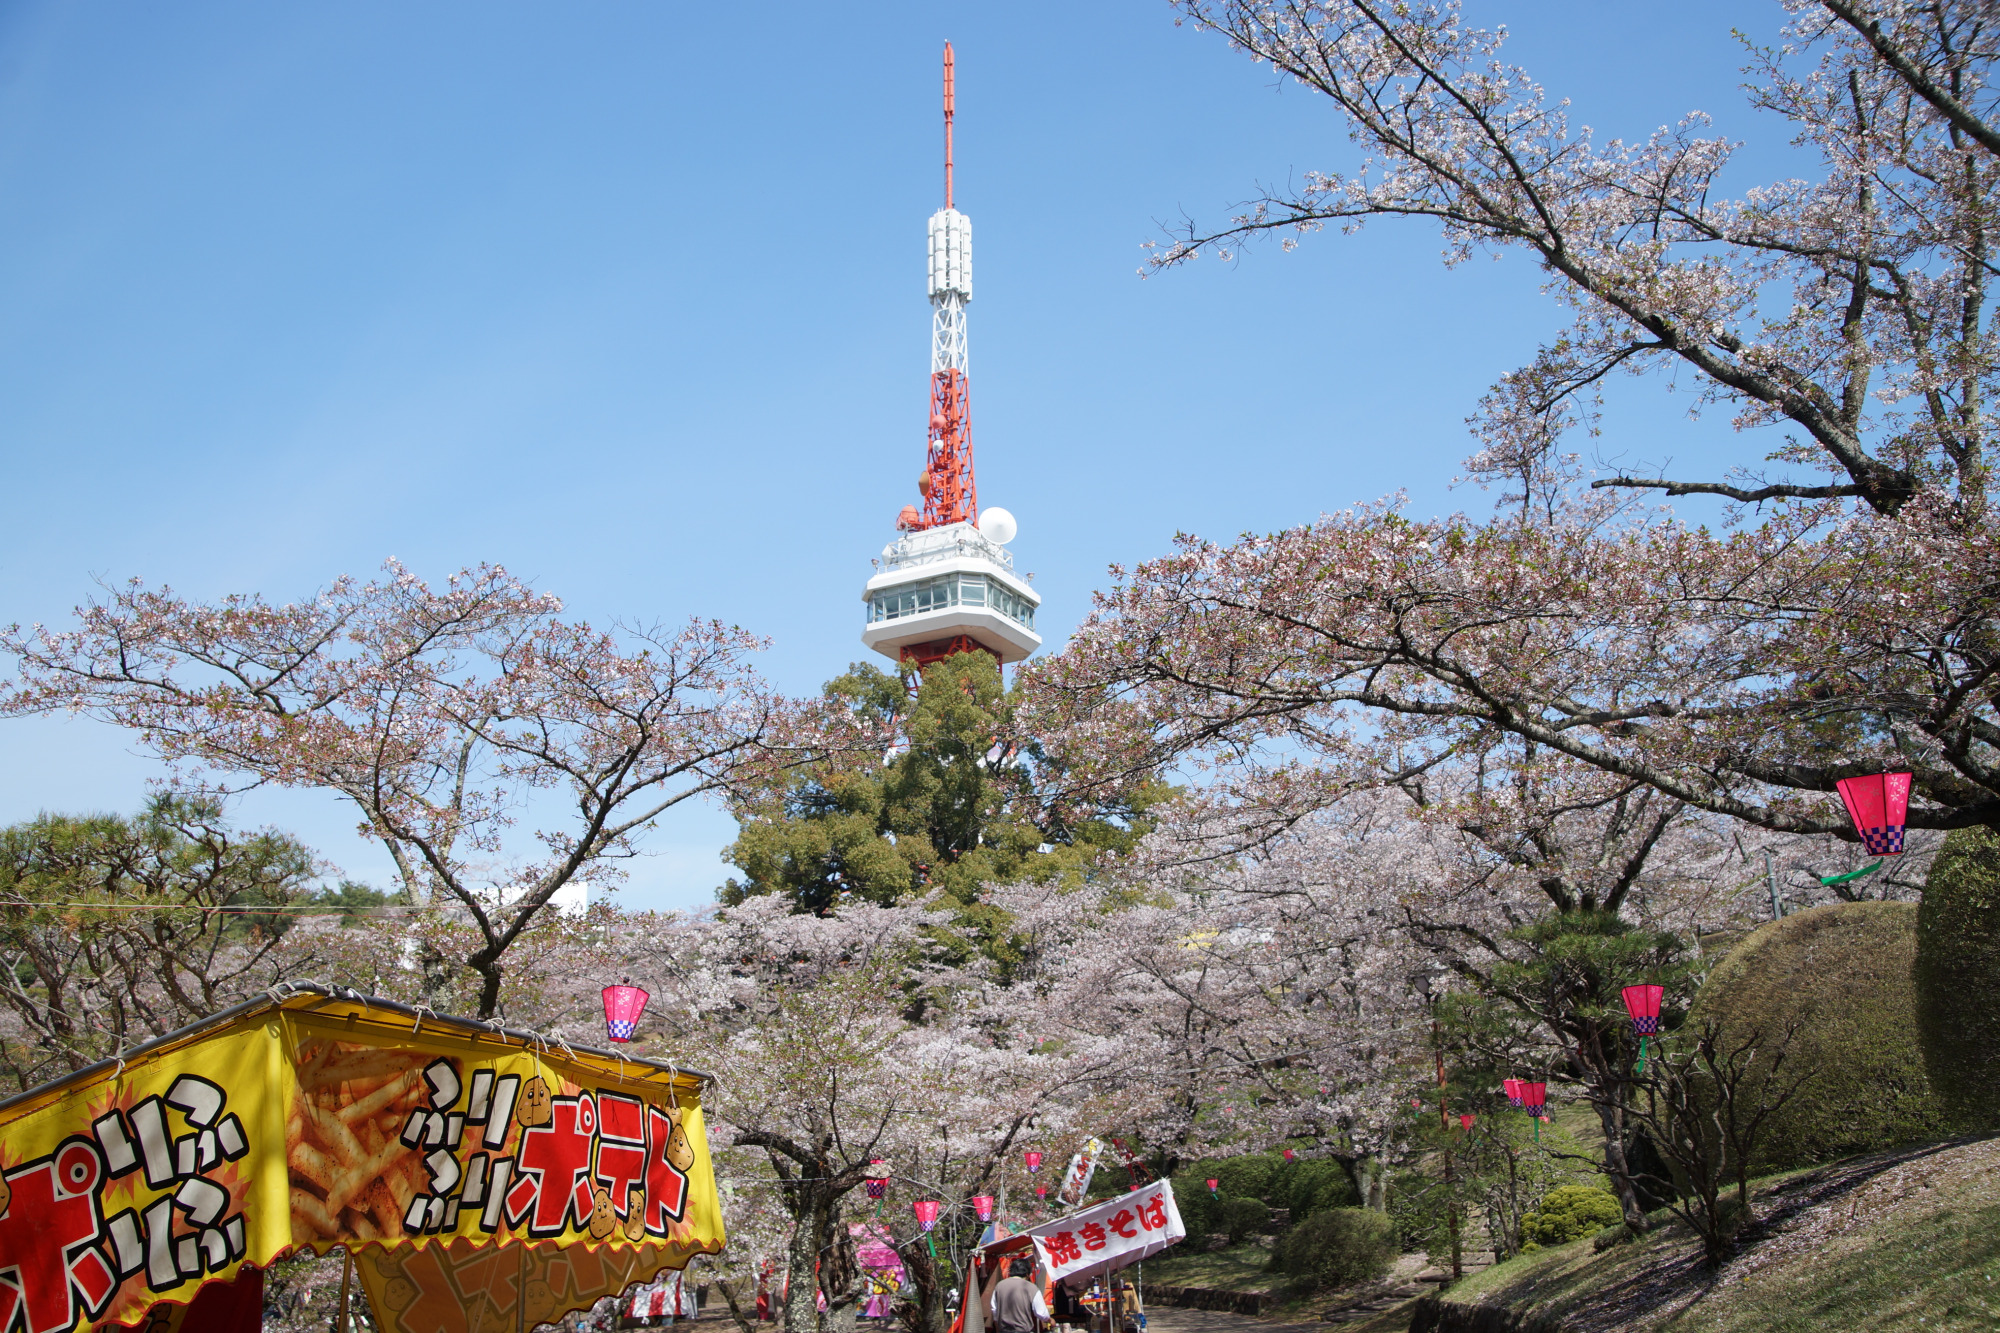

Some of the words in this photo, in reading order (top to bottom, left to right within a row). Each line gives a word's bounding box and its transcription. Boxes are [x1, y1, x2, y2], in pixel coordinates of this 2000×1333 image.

[504, 1088, 690, 1238] ポテト
[1043, 1192, 1168, 1269] 焼きそば
